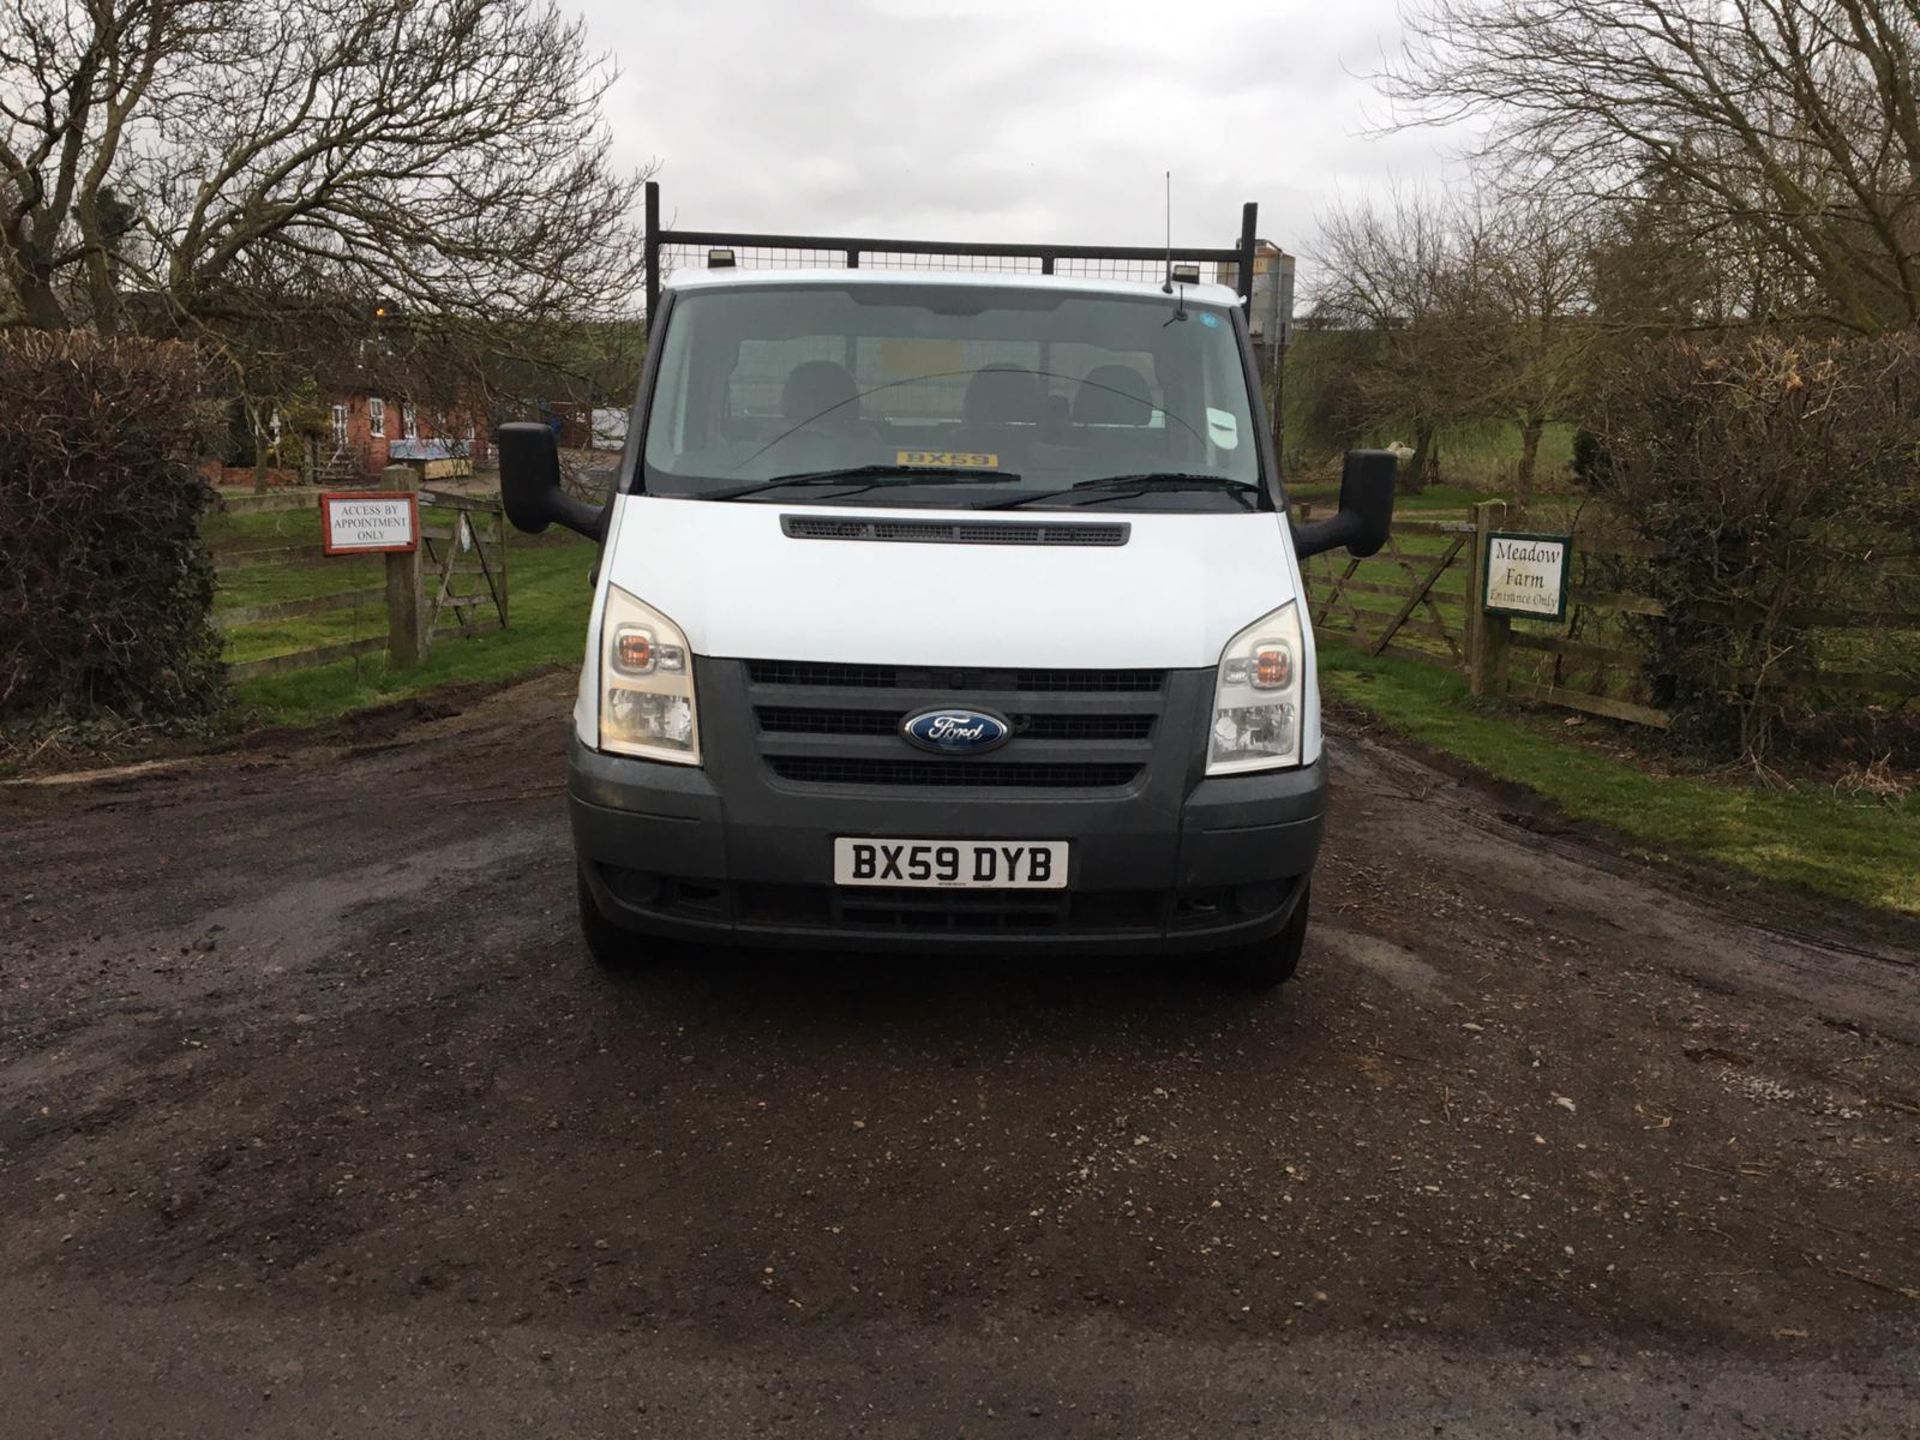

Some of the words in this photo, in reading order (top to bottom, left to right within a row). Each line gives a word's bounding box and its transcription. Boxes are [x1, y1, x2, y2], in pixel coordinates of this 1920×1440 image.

[342, 504, 381, 516] ACCESS
[384, 503, 398, 515] BY
[335, 517, 407, 529] APPOINTMENT
[357, 531, 384, 541] ONLY
[1496, 541, 1560, 563] Meadow
[1506, 568, 1544, 588] Farm
[1490, 589, 1531, 605] Entrance
[1533, 593, 1557, 608] Only
[928, 716, 984, 740] Ford
[852, 844, 960, 881] BX59
[972, 847, 1052, 882] DYB
